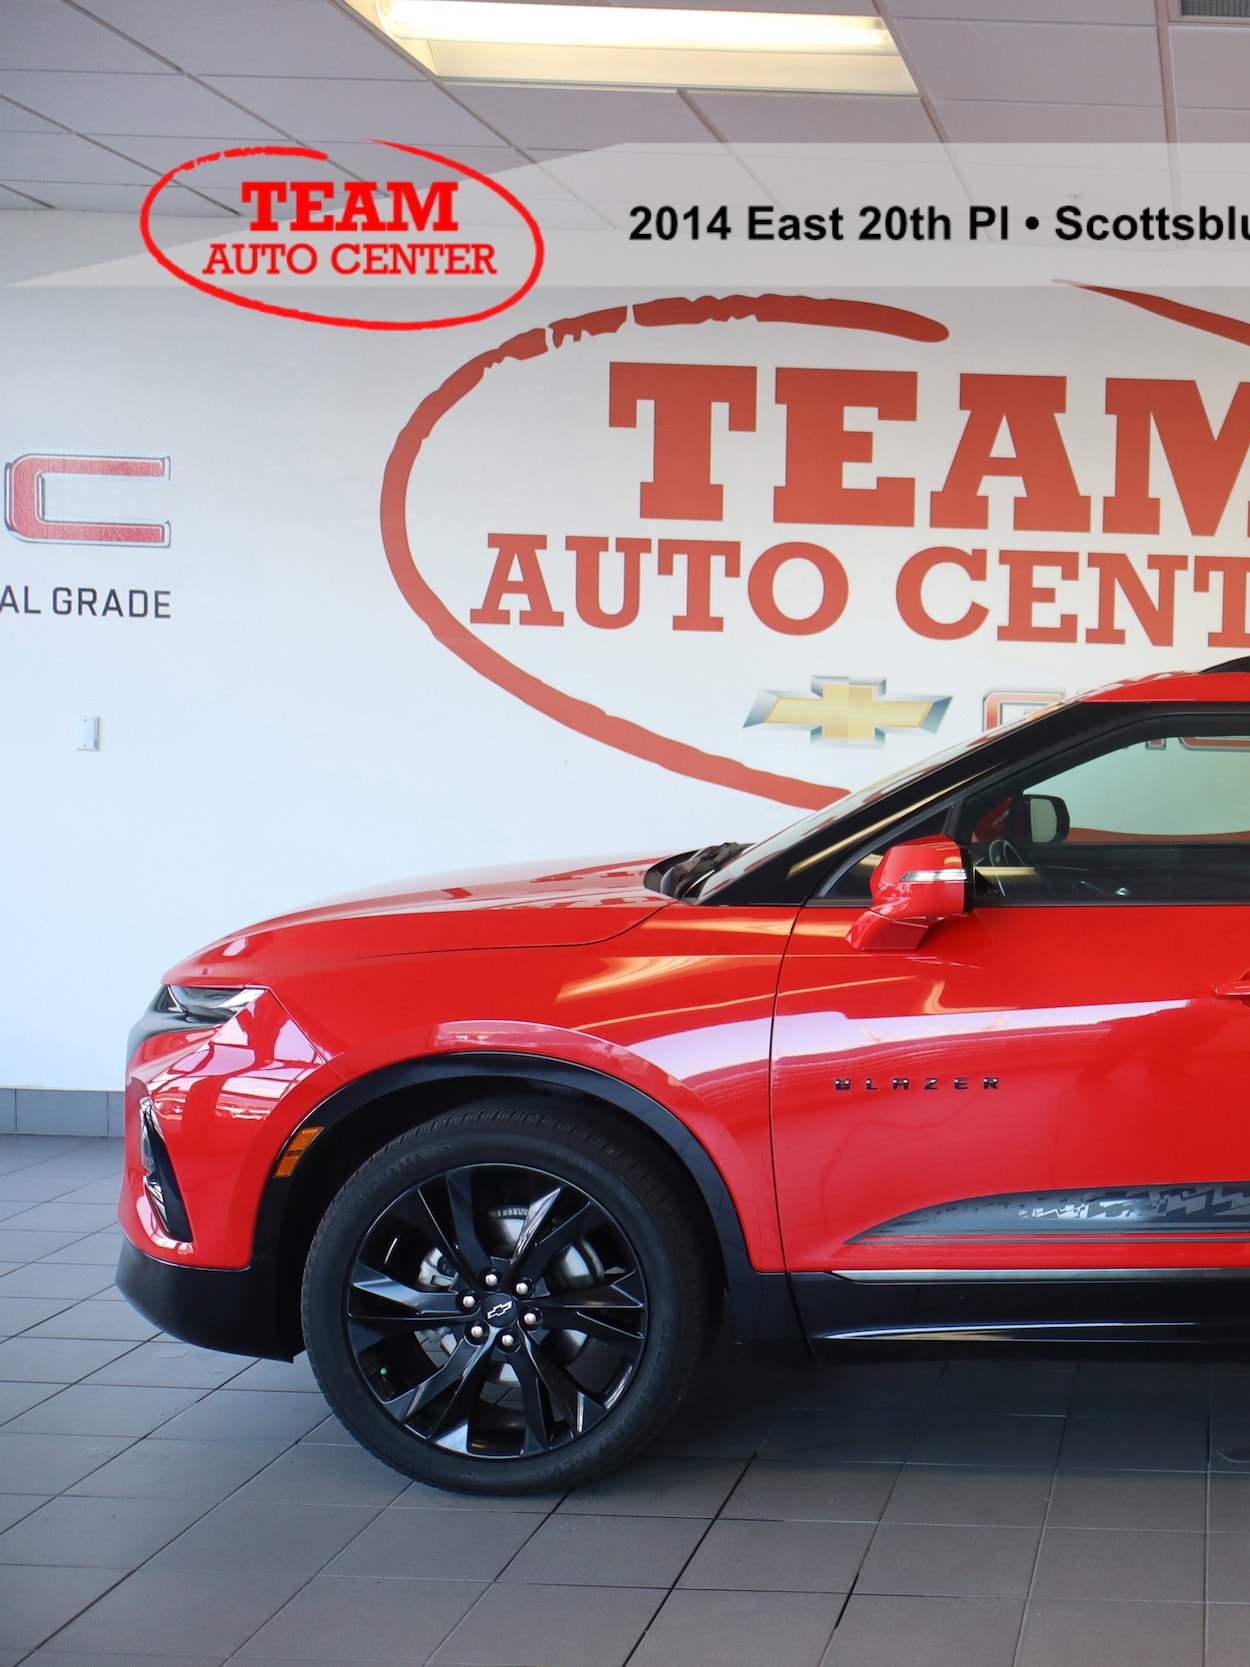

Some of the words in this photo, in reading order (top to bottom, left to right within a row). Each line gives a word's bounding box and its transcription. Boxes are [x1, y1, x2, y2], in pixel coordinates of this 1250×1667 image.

[470, 533, 849, 636] AUTO
[52, 586, 171, 619] GRADE
[834, 1077, 999, 1091] BLAZER
